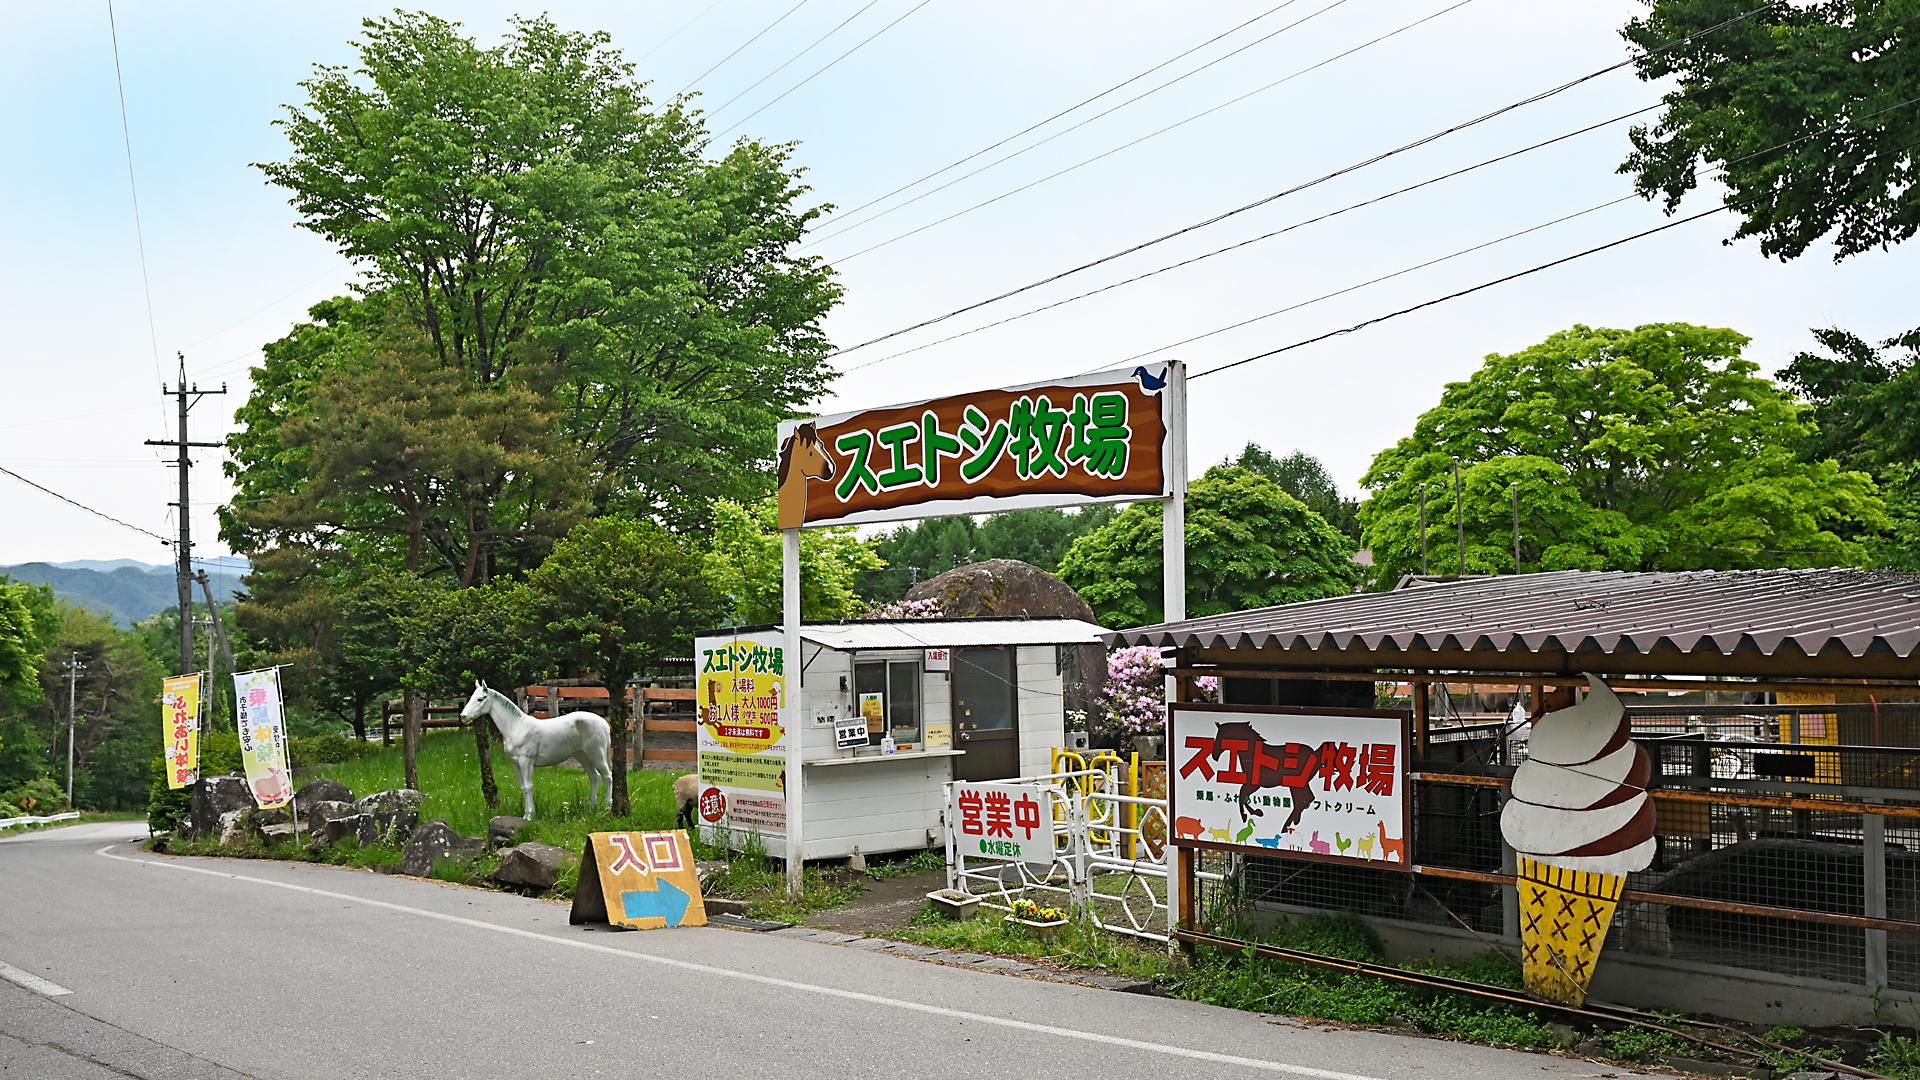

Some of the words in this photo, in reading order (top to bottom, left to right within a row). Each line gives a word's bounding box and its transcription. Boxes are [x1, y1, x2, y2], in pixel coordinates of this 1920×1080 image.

[836, 392, 1130, 501] スエトシ牧場
[702, 645, 784, 677] スエトシ牧場
[928, 651, 948, 661] 入場受付
[731, 678, 755, 693] 入場料
[760, 712, 778, 725] 500円
[839, 727, 865, 739] 営業中
[1179, 736, 1396, 796] スエトシ牧場
[958, 789, 1041, 840] 営業中
[608, 832, 684, 877] 入口
[987, 840, 1021, 858] 水曜定休
